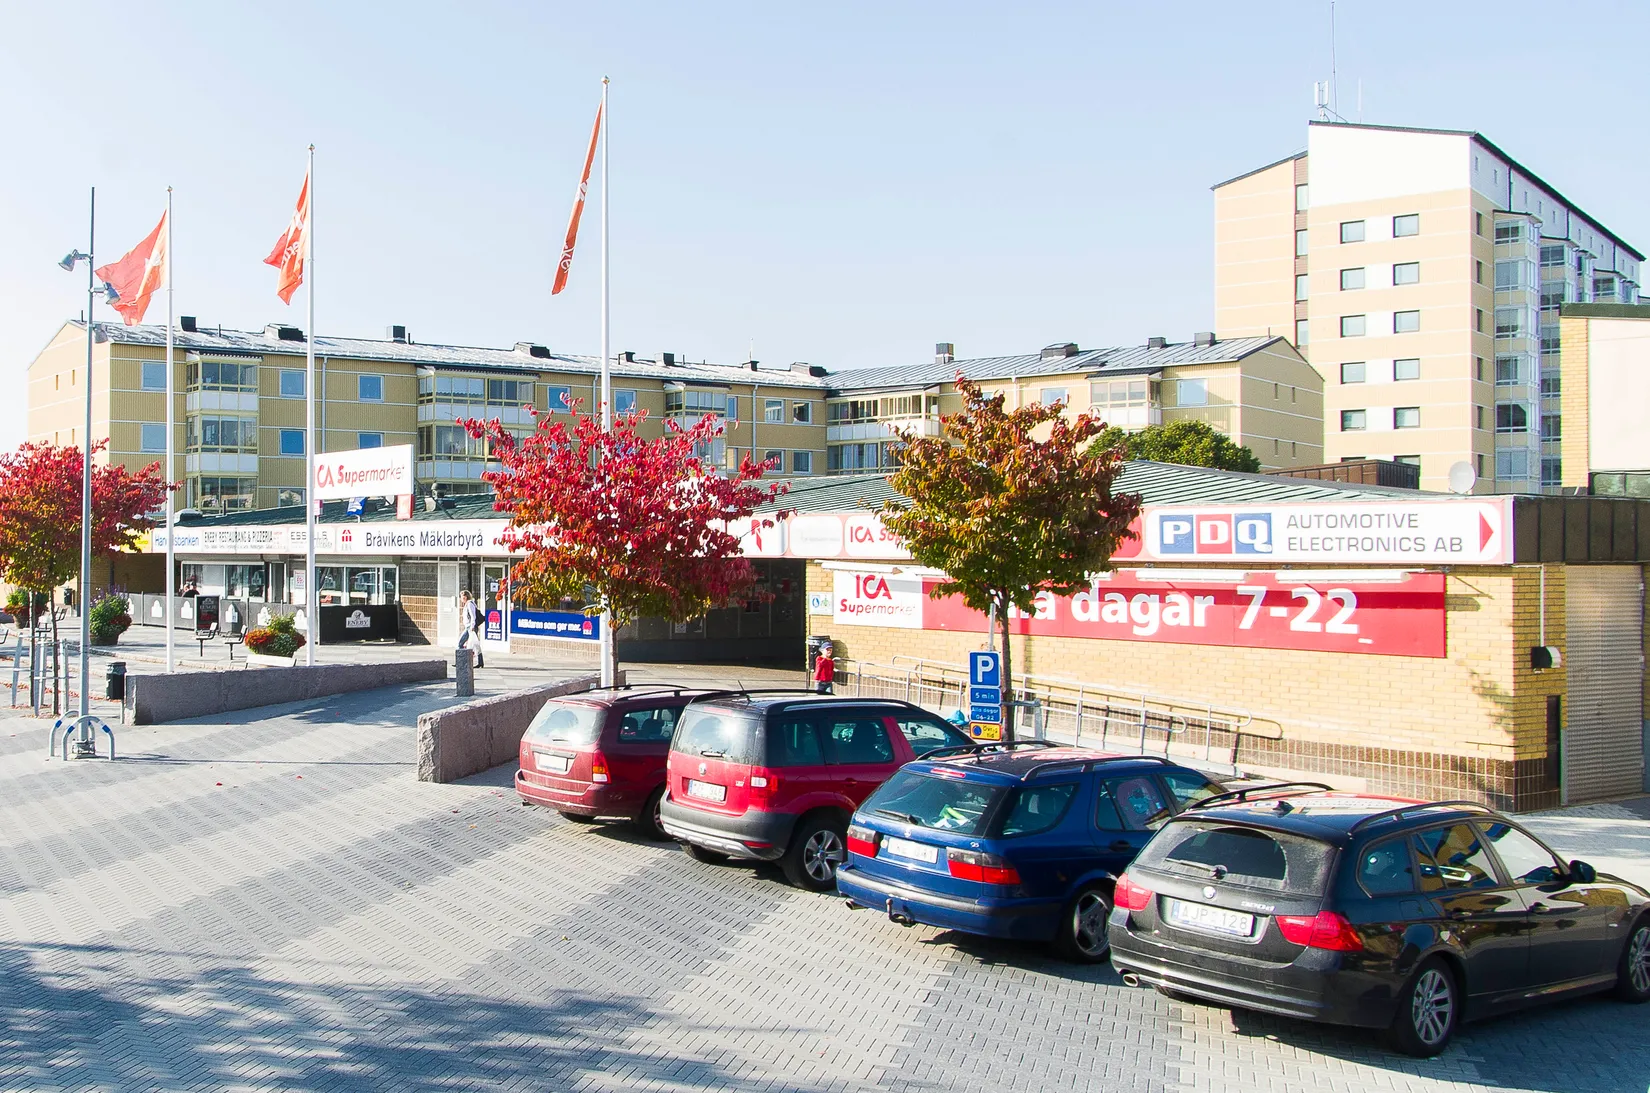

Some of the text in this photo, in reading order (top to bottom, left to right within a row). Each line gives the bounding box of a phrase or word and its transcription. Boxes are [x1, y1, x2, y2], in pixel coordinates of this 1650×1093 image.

[1286, 513, 1419, 529] AUTOMOTIVE
[366, 529, 483, 550] Bråvikens Mäklarbyrå
[850, 526, 874, 543] ICA
[1287, 536, 1463, 552] ELECTRONICS AB
[855, 574, 892, 600] ICA
[1071, 577, 1214, 636] dagar
[1236, 585, 1359, 634] 7-22
[977, 655, 994, 683] P
[981, 692, 995, 700] min
[983, 707, 999, 715] dagar
[1182, 905, 1248, 930] AJP 128
